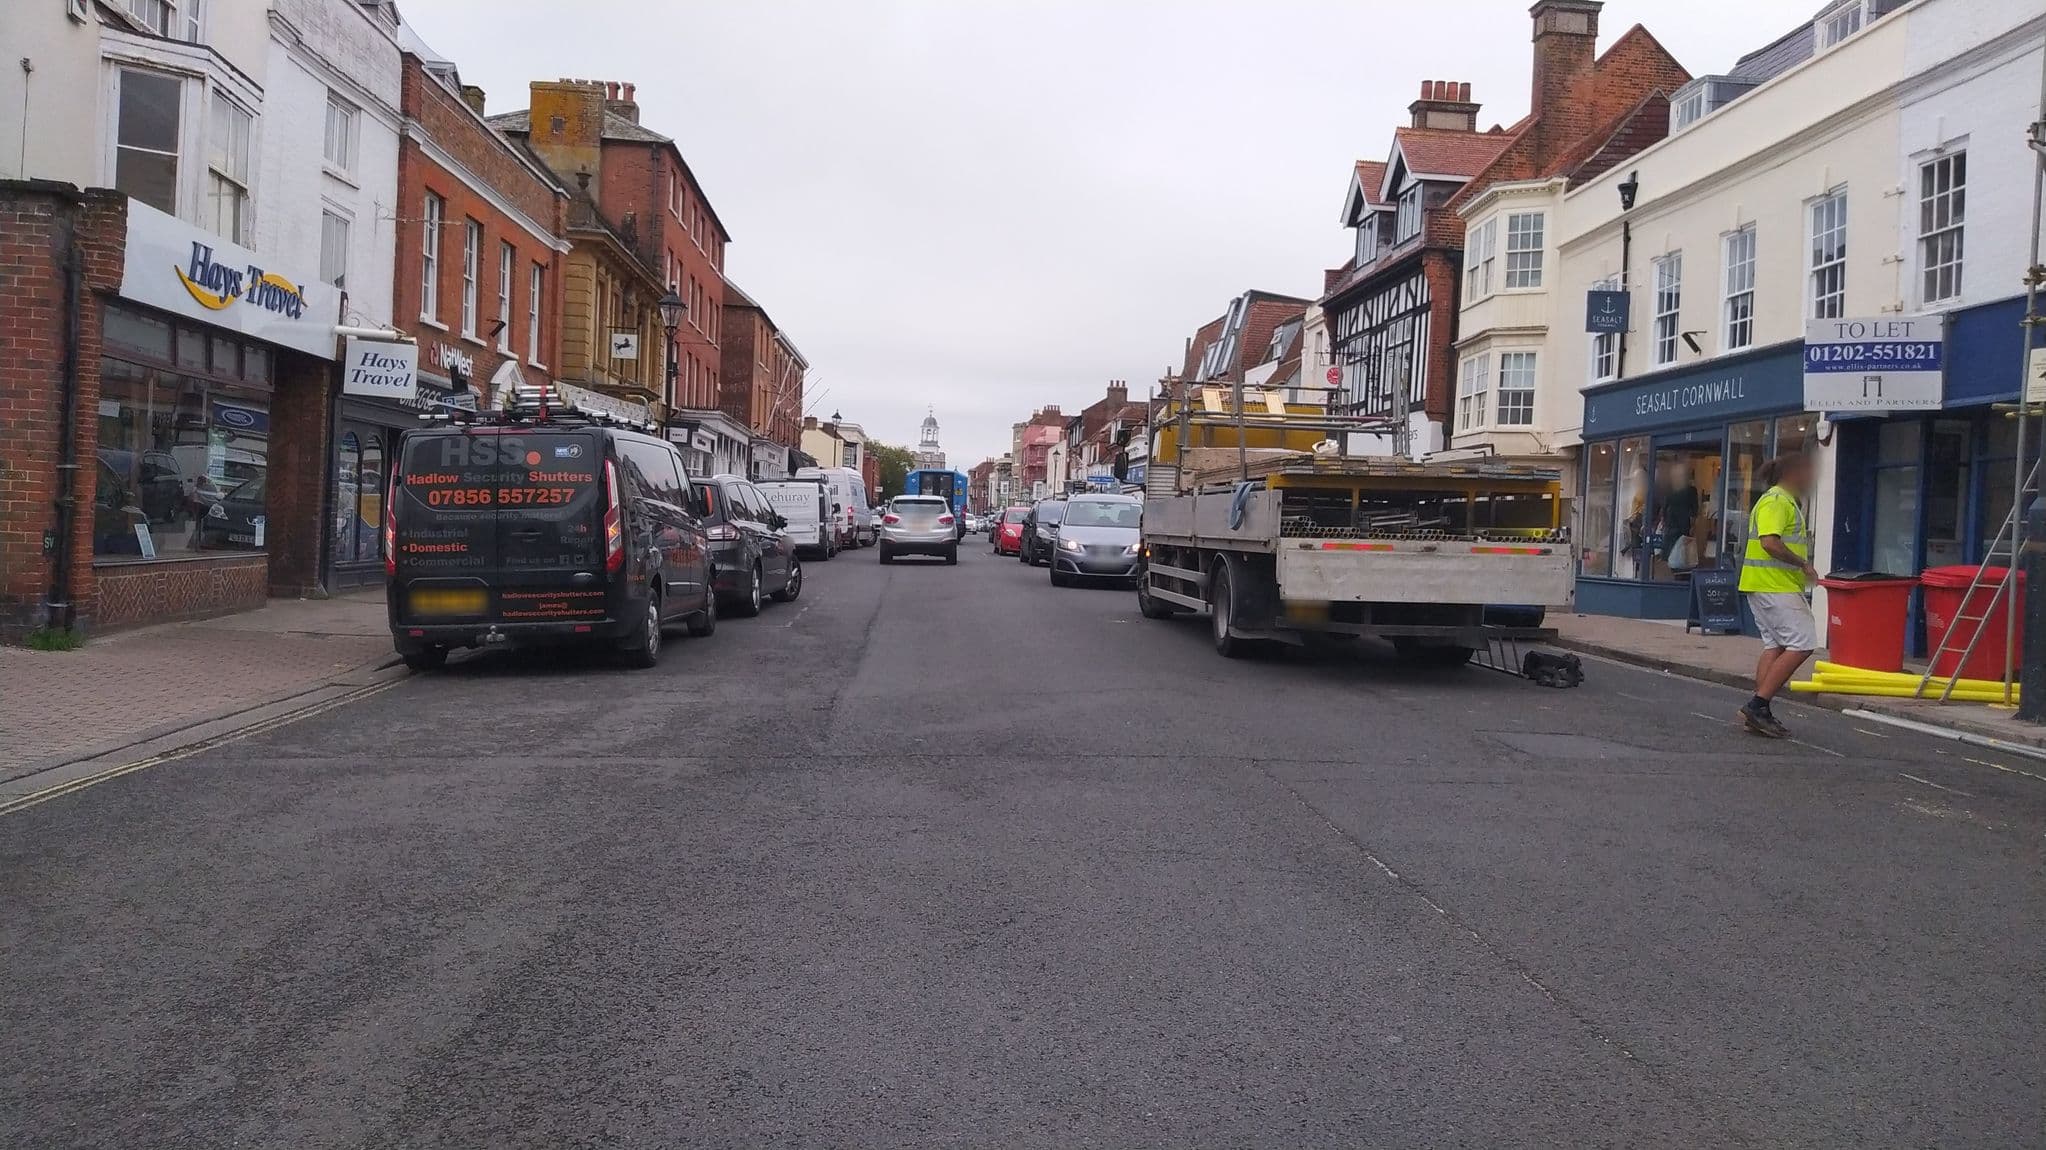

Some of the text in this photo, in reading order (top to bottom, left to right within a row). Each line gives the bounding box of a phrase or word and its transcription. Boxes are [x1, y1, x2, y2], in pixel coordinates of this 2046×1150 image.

[188, 240, 304, 320] Hays Travel
[1592, 315, 1623, 324] SEASALT
[1834, 321, 1915, 339] TO LET
[440, 343, 474, 377] NatWest
[1809, 343, 1937, 361] 01202-551821
[351, 352, 411, 387] Hays Travel
[1635, 376, 1745, 415] SEASALT CORNWALL
[406, 470, 593, 485] Hadlow Security Shutters
[428, 487, 576, 506] 07856 557257
[409, 528, 468, 538] Industrial
[409, 543, 468, 553] Domestic
[409, 556, 485, 568] Commercial
